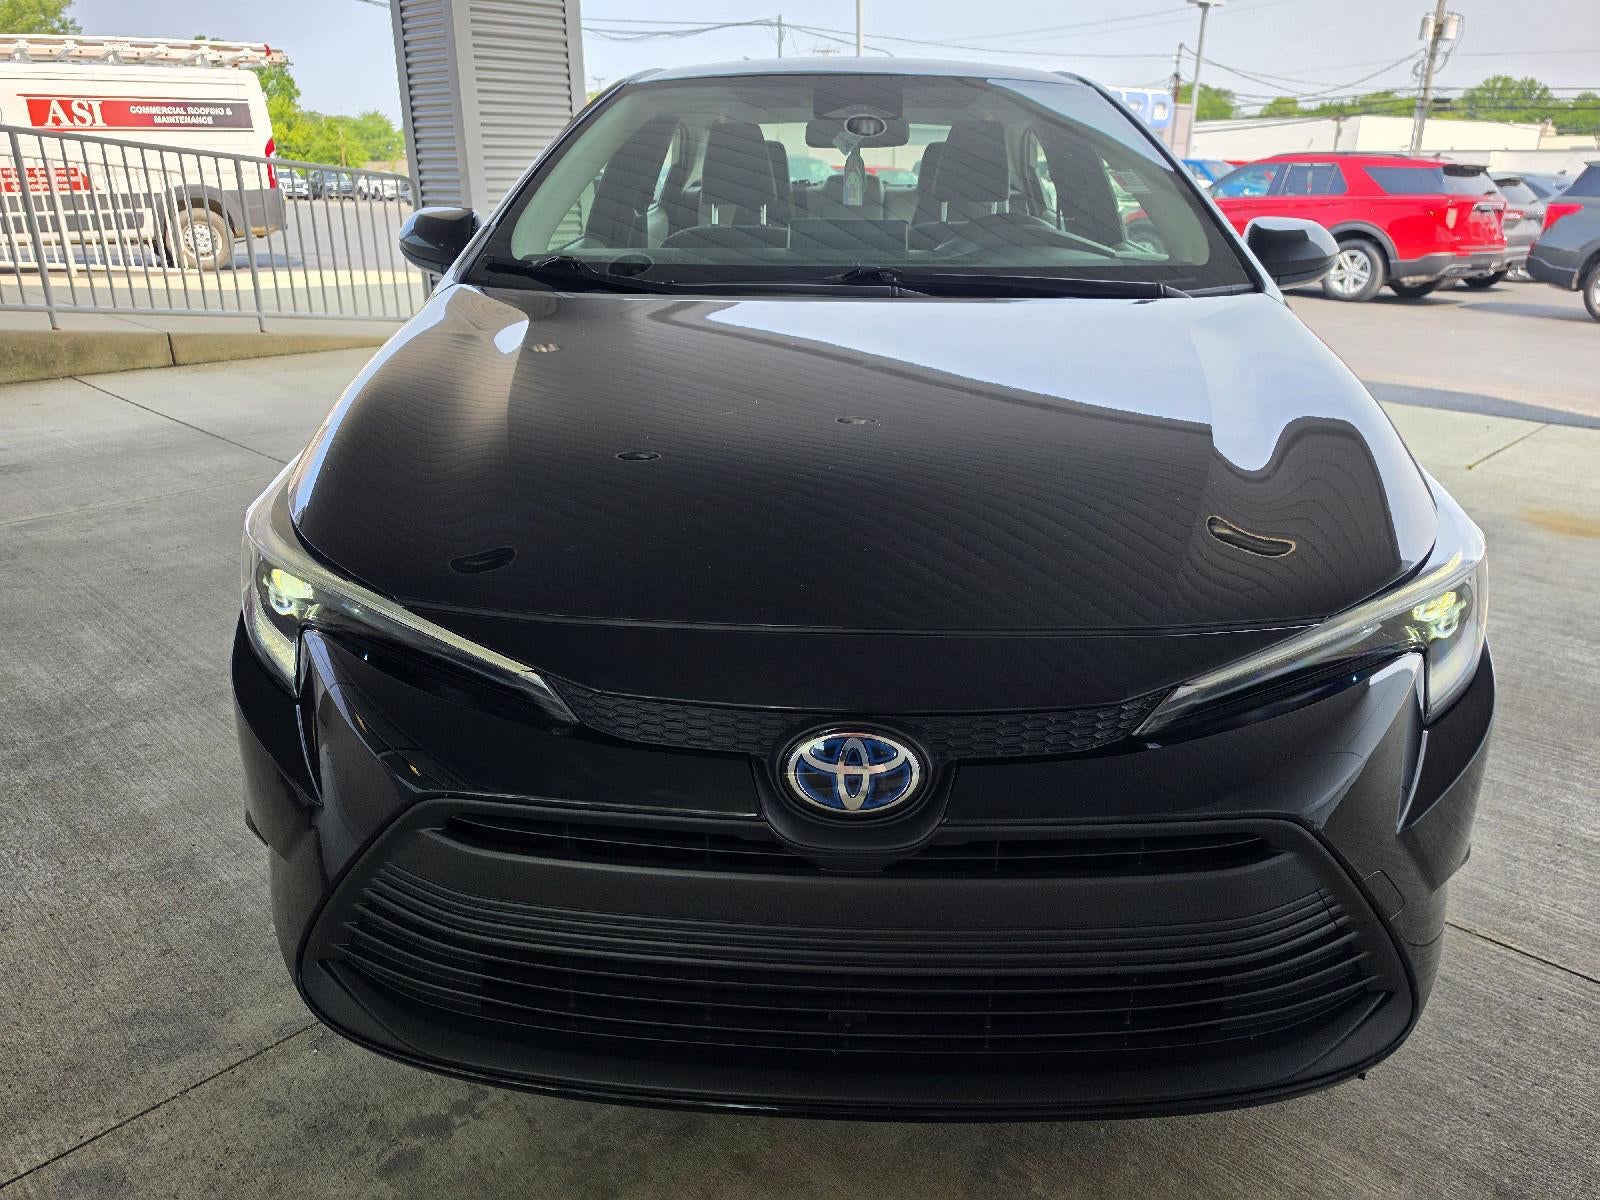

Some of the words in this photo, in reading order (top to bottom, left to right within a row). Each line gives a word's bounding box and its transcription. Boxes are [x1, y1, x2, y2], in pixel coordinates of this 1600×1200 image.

[45, 98, 107, 127] ASI
[129, 105, 187, 115] COMMERCIAL
[187, 106, 224, 115] ROOFING
[225, 107, 233, 116] &
[153, 115, 214, 124] MAINTENANCE
